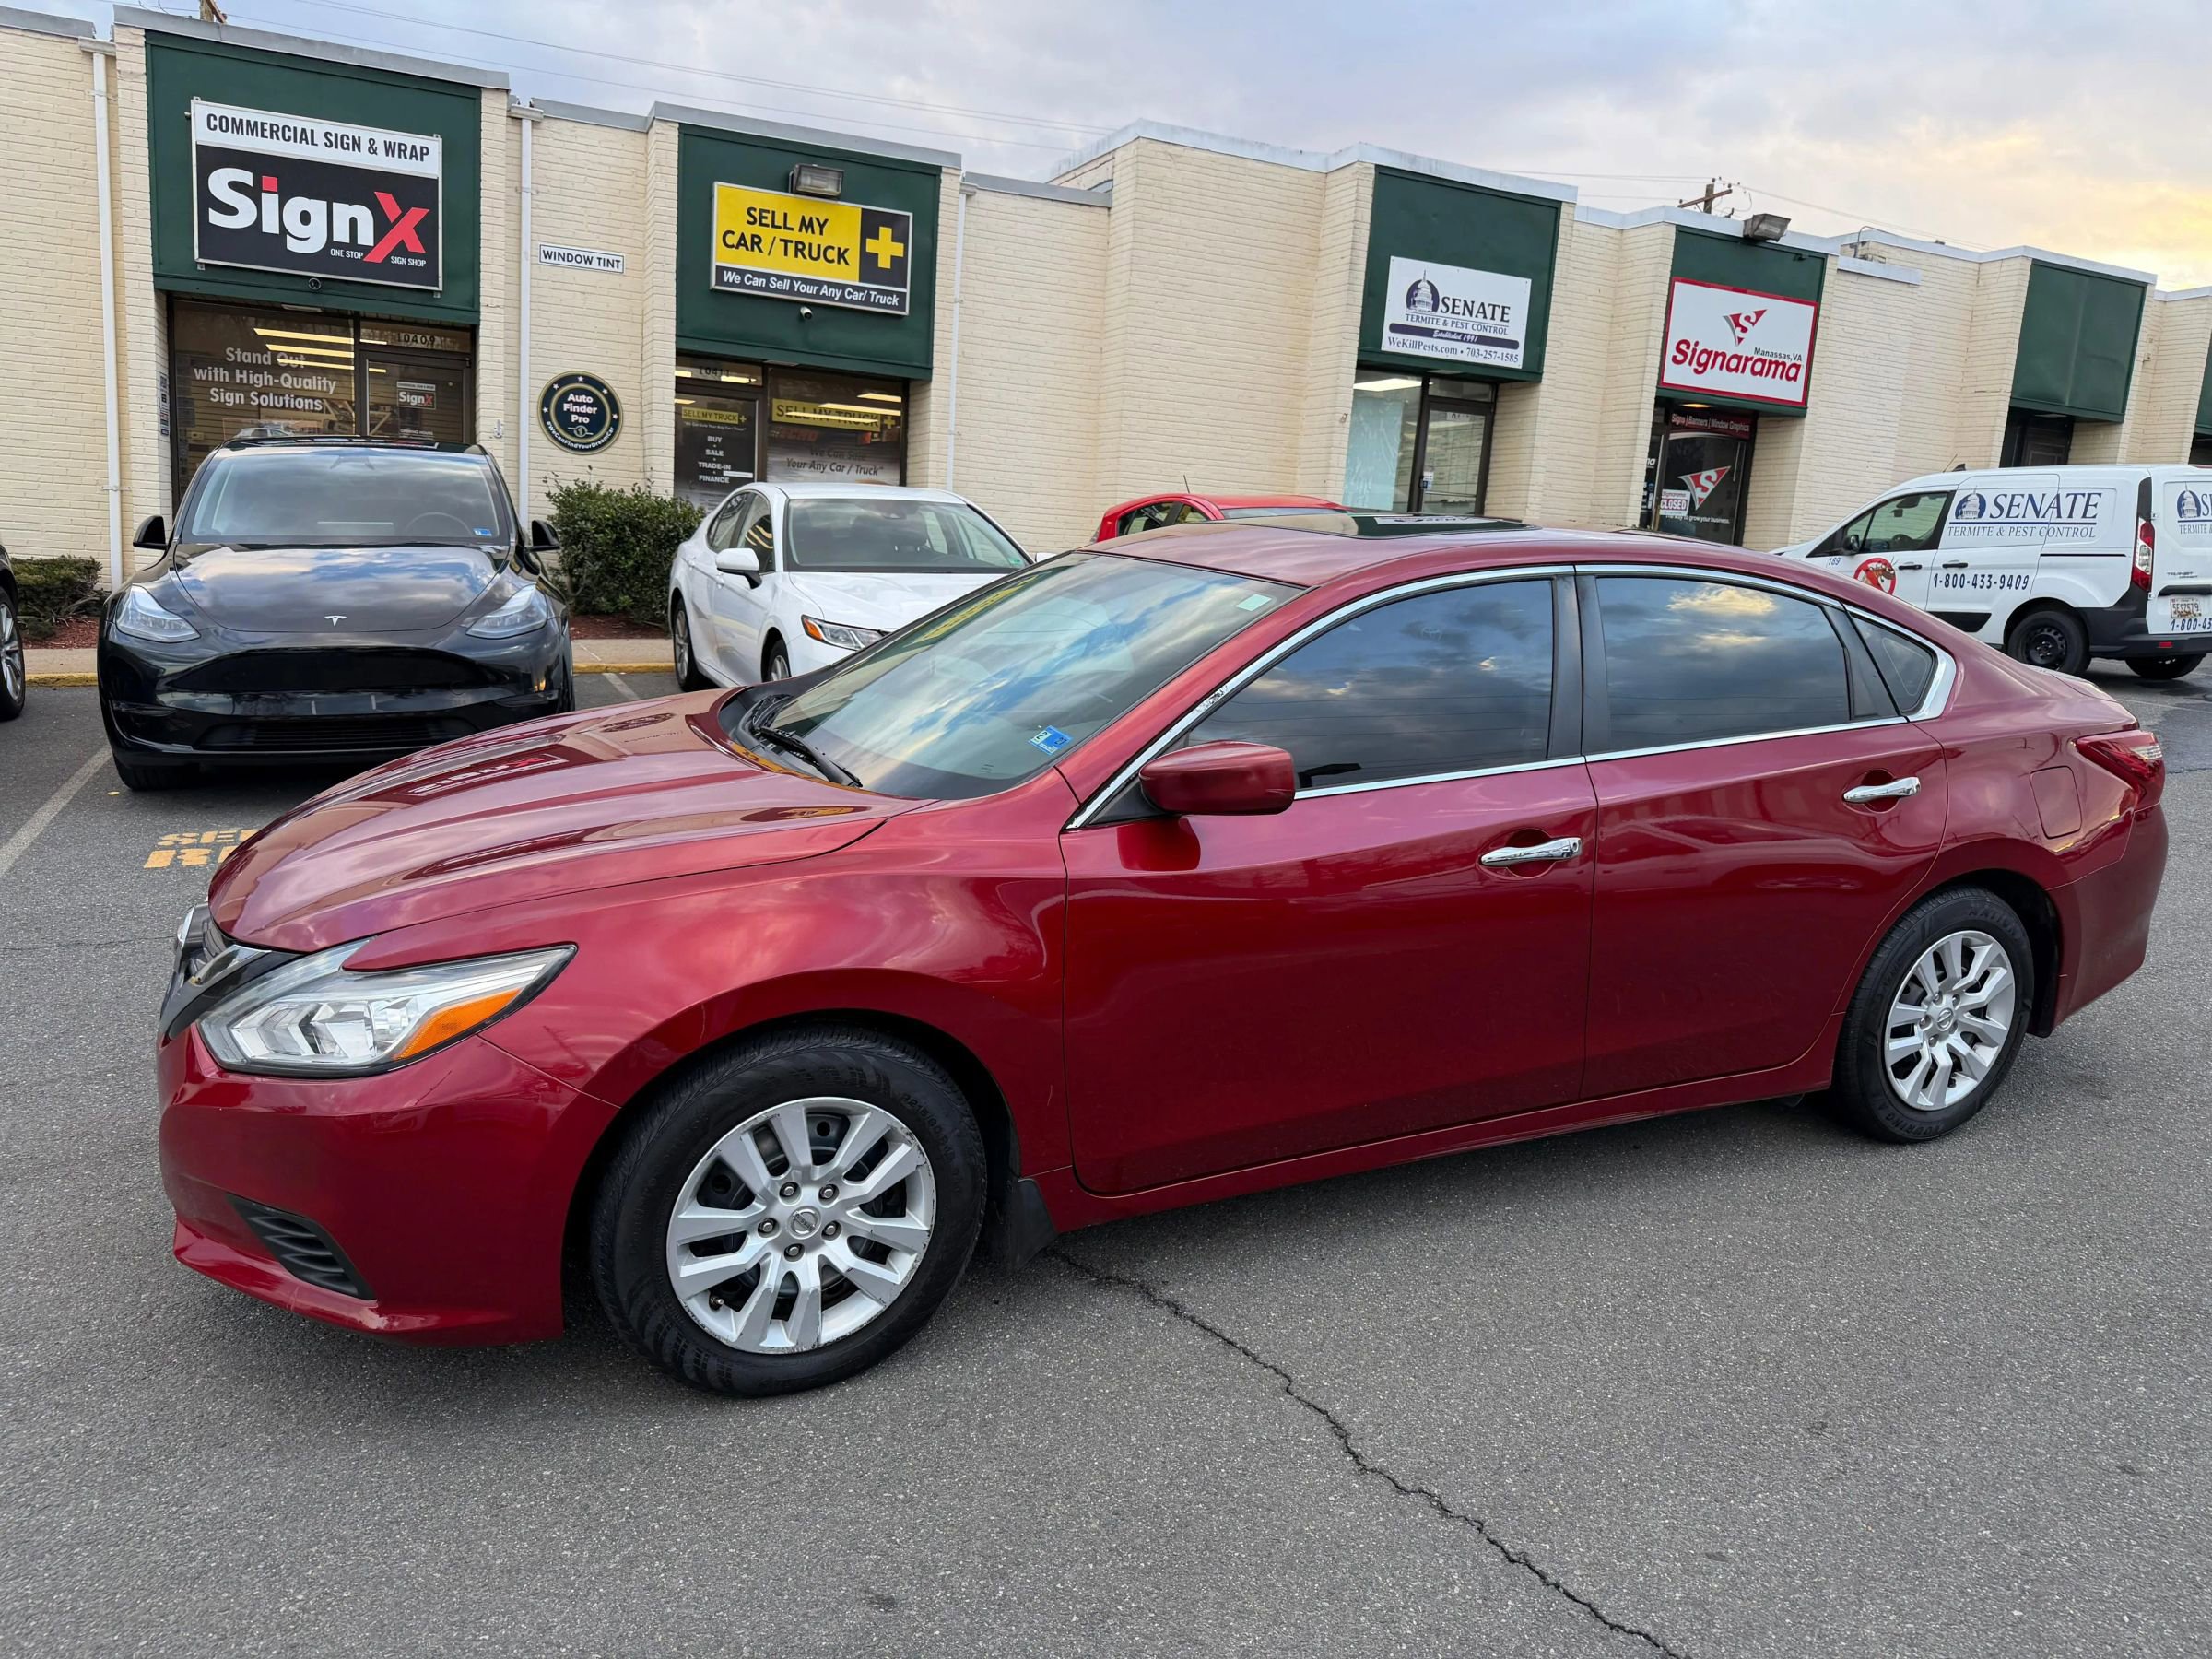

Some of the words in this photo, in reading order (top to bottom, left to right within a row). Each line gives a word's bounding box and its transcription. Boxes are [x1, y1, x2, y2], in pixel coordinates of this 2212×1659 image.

[206, 113, 318, 147] COMMERCIAL
[324, 131, 361, 152] SIGN
[368, 138, 378, 155] &
[384, 140, 429, 161] WRAP
[207, 168, 430, 263] SignX
[747, 207, 794, 231] SELL
[798, 216, 829, 236] MY
[723, 230, 763, 253] CAR
[768, 237, 776, 256] /
[780, 239, 850, 265] TRUCK
[331, 249, 344, 257] ONE
[346, 251, 363, 259] STOP
[391, 256, 406, 265] SIGN
[543, 250, 594, 265] WINDOW
[596, 257, 620, 269] TINT
[723, 270, 741, 284] We
[744, 274, 765, 288] Can
[769, 277, 790, 290] Sell
[794, 280, 818, 295] Your
[820, 285, 841, 300] Any
[844, 288, 866, 301] Car/
[869, 291, 899, 306] Truck
[1440, 296, 1511, 323] SENATE
[1406, 313, 1440, 325] TERMITE
[1451, 321, 1469, 330] PEST
[1471, 324, 1508, 335] CONTROL
[397, 333, 435, 345] 10409
[226, 347, 271, 365] Stand
[1387, 336, 1458, 355] WeKillPests.com
[1466, 347, 1519, 363] 703-257-1585
[1672, 338, 1802, 382] Signarama
[194, 367, 229, 382] with
[236, 369, 336, 394] High-Quality
[210, 388, 244, 406] Sign
[251, 392, 323, 411] Solutions
[568, 394, 593, 403] Auto
[563, 403, 597, 414] Finder
[684, 409, 700, 418] SELL
[714, 413, 736, 421] TRUCK
[777, 405, 809, 419] SELL
[571, 415, 590, 423] Pro
[698, 462, 731, 470] TRADE-IN
[786, 458, 808, 469] Your
[809, 460, 828, 473] Any
[830, 462, 845, 473] Car
[699, 475, 730, 483] FINANCE
[1660, 499, 1687, 510] CLOSED
[1989, 492, 2102, 519] SENATE
[1947, 526, 1994, 537] TERMITE
[1996, 528, 2005, 537] &
[2008, 526, 2037, 537] PEST
[2039, 526, 2096, 538] CONTROL
[2179, 524, 2208, 535] TERMITE
[1934, 573, 2030, 590] 1-800-433-9409
